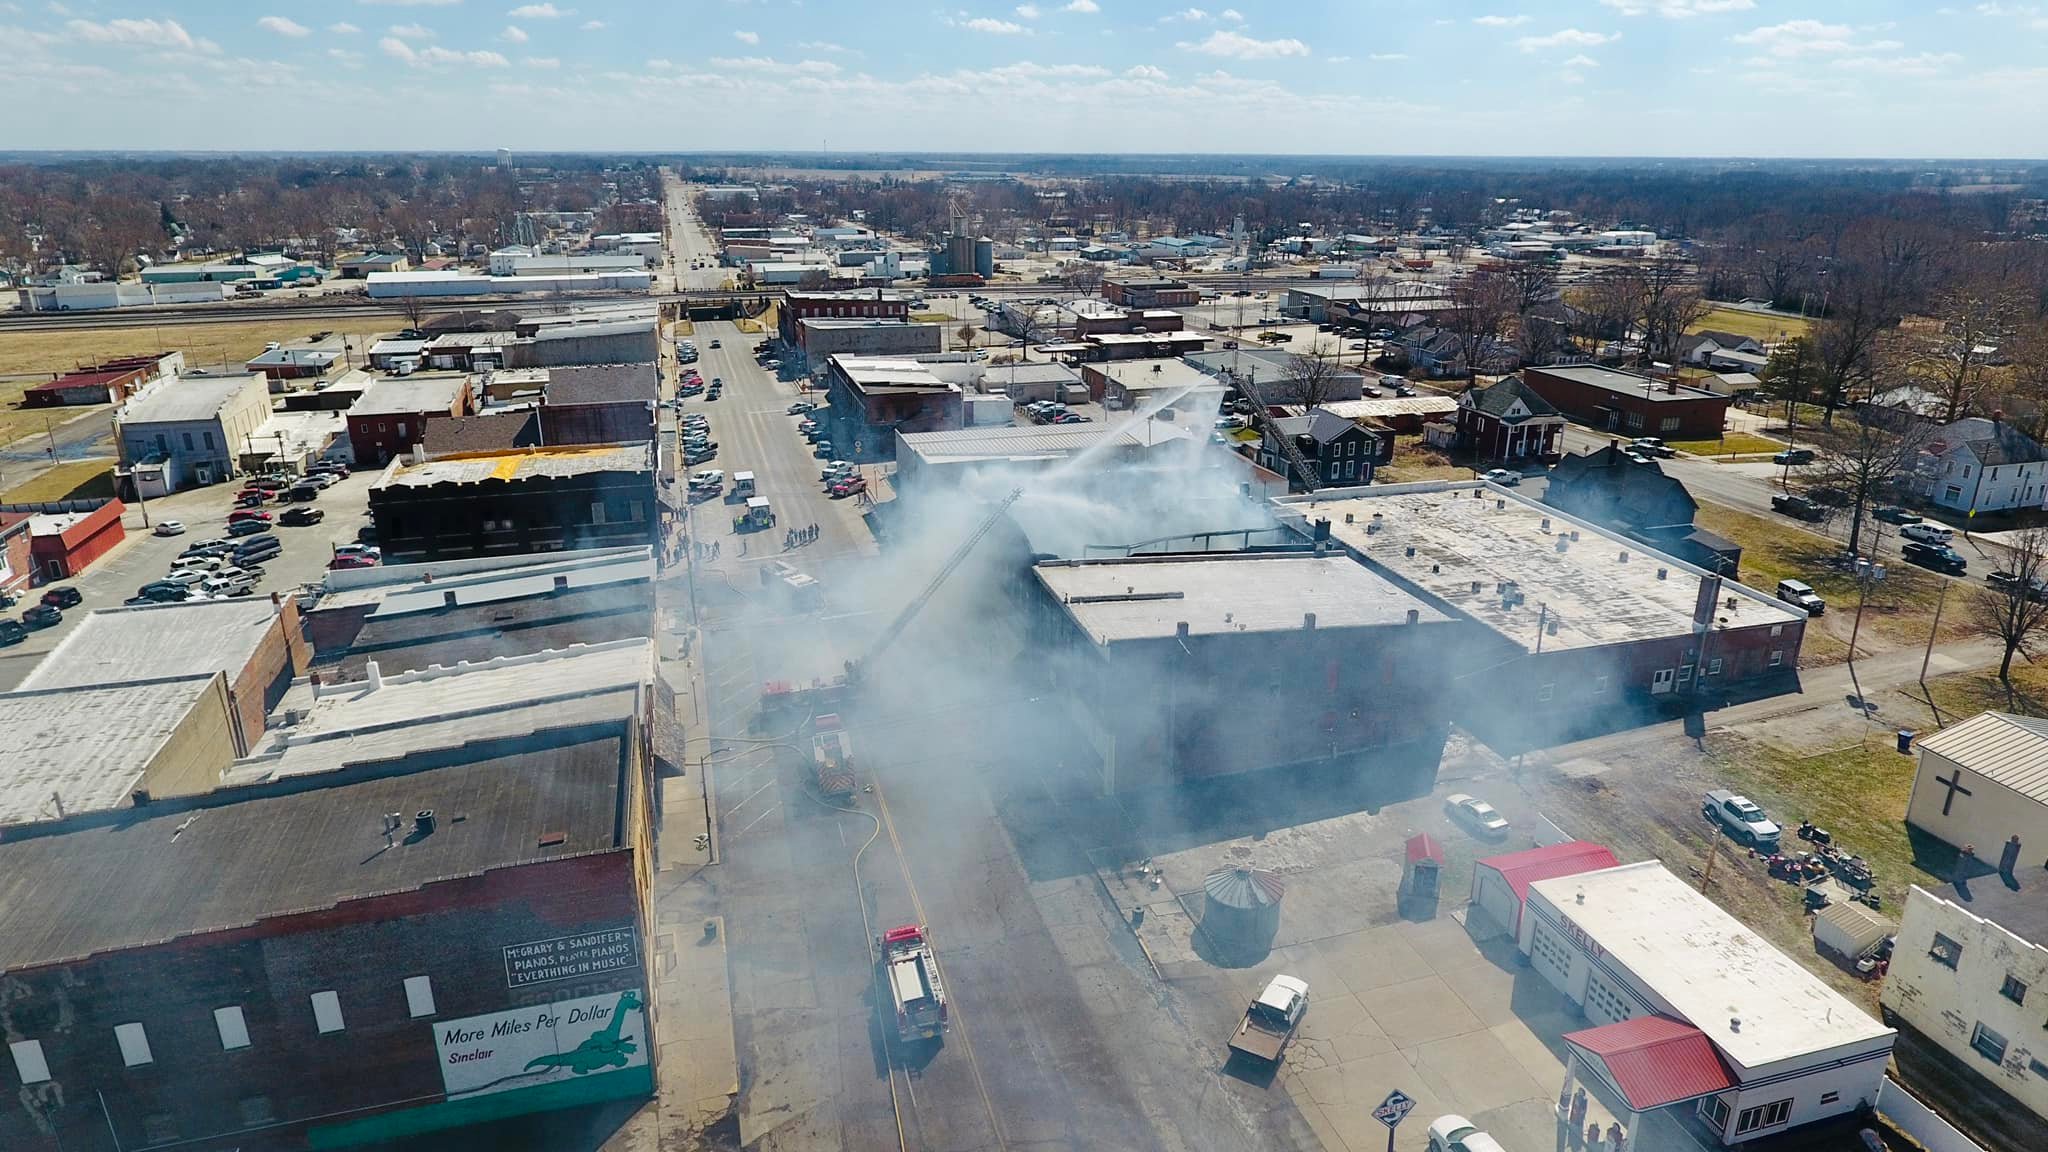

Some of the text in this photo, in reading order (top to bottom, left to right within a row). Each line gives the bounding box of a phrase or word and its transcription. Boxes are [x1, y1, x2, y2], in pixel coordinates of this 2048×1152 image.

[557, 941, 565, 951] &
[570, 932, 622, 948] SANDIFER
[1560, 916, 1605, 958] SKELLY
[592, 944, 629, 958] PIANOS
[579, 962, 589, 973] IN
[444, 1005, 611, 1046] More Miles Per Dollar
[448, 1048, 494, 1064] Sinclair
[1377, 1100, 1410, 1116] SKELLY
